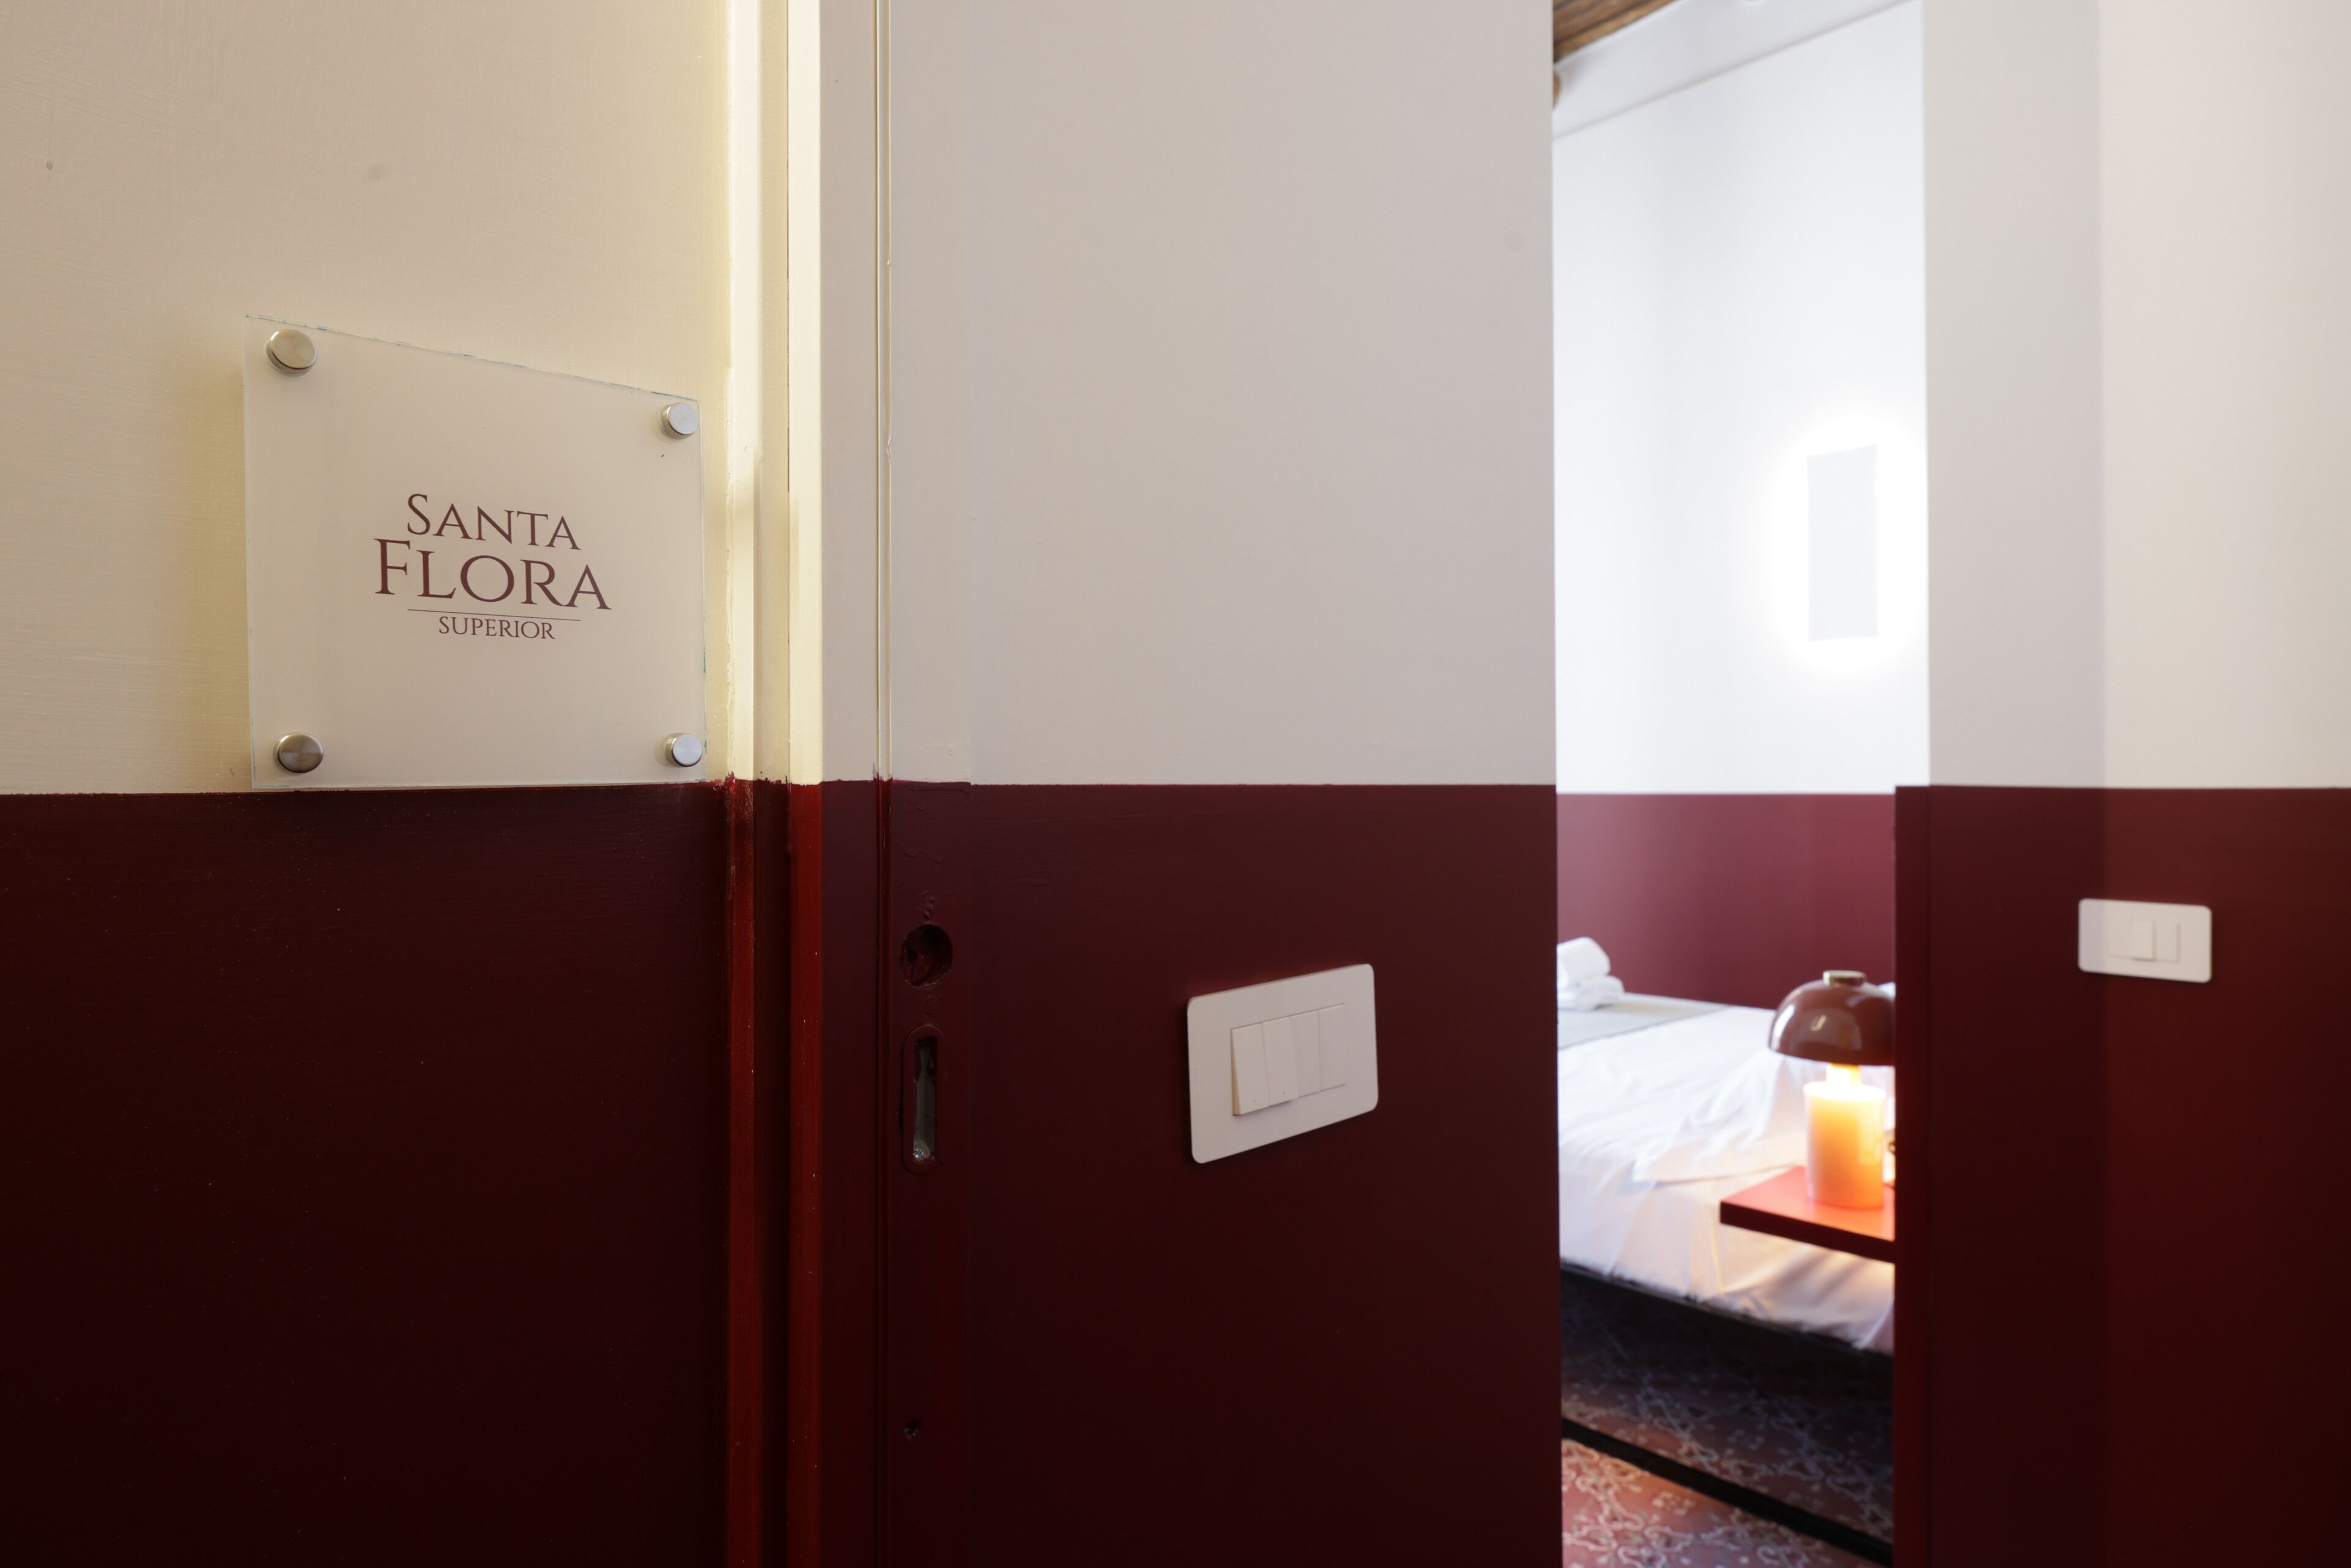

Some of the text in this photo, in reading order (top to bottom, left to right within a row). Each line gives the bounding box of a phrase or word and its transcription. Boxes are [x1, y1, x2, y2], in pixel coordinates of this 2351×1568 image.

[407, 493, 582, 550] SANTA
[373, 538, 612, 610] FLORA
[438, 615, 556, 640] SUPERIOR
